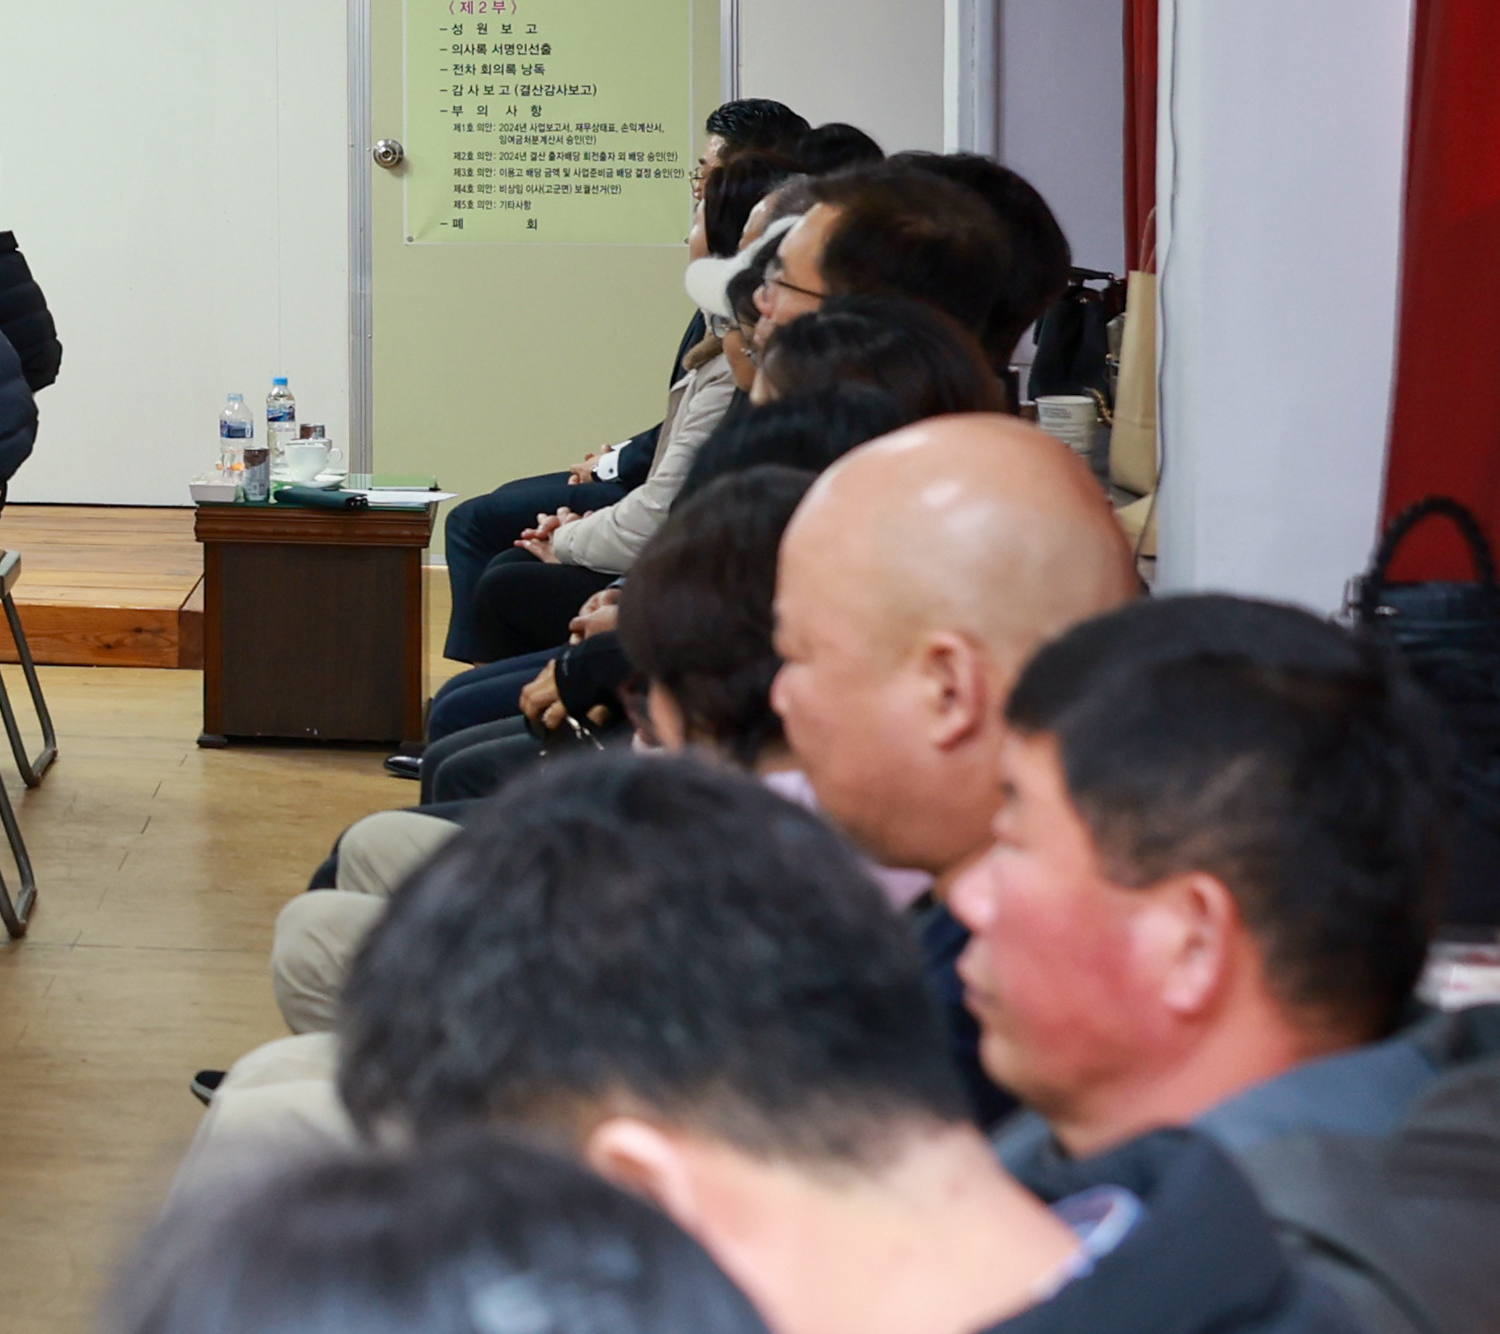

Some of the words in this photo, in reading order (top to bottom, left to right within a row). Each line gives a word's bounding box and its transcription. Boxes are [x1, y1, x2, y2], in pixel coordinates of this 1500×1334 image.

[451, 43, 487, 55] 의사록
[491, 42, 553, 56] 서명인선출
[452, 63, 477, 76] 전차
[480, 63, 517, 76] 회의록
[520, 63, 546, 76] 낭독
[514, 83, 597, 97] (결산감사보고)
[499, 123, 527, 133] 2024년
[499, 151, 527, 162] 2024년
